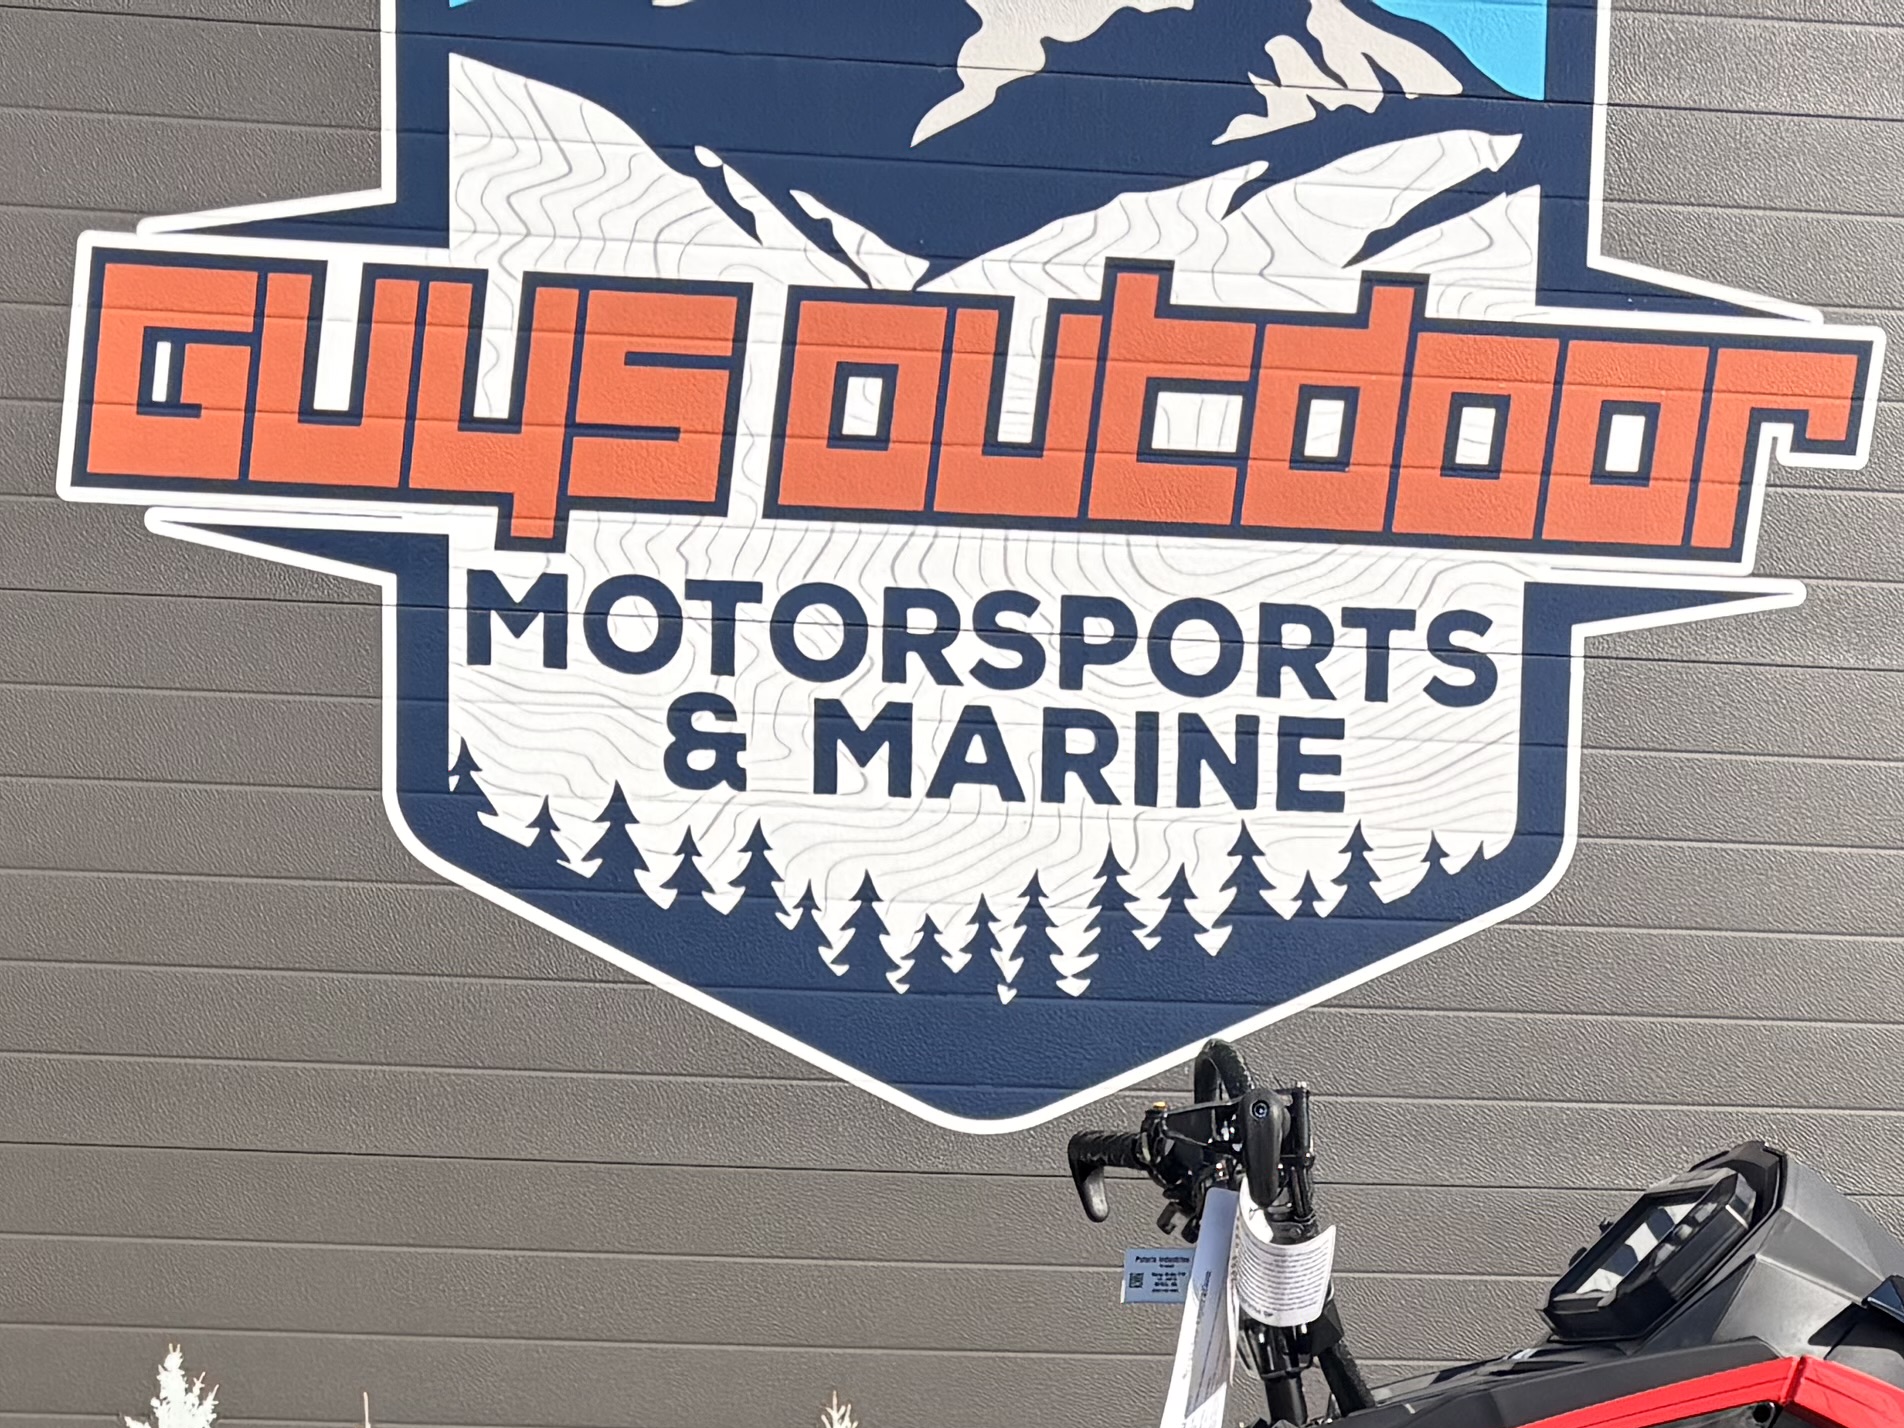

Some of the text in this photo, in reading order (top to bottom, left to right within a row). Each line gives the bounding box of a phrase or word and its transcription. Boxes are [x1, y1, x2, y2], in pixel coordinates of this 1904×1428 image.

[465, 568, 1498, 708] MOTORSPORTS
[663, 691, 1345, 813] & MARINE
